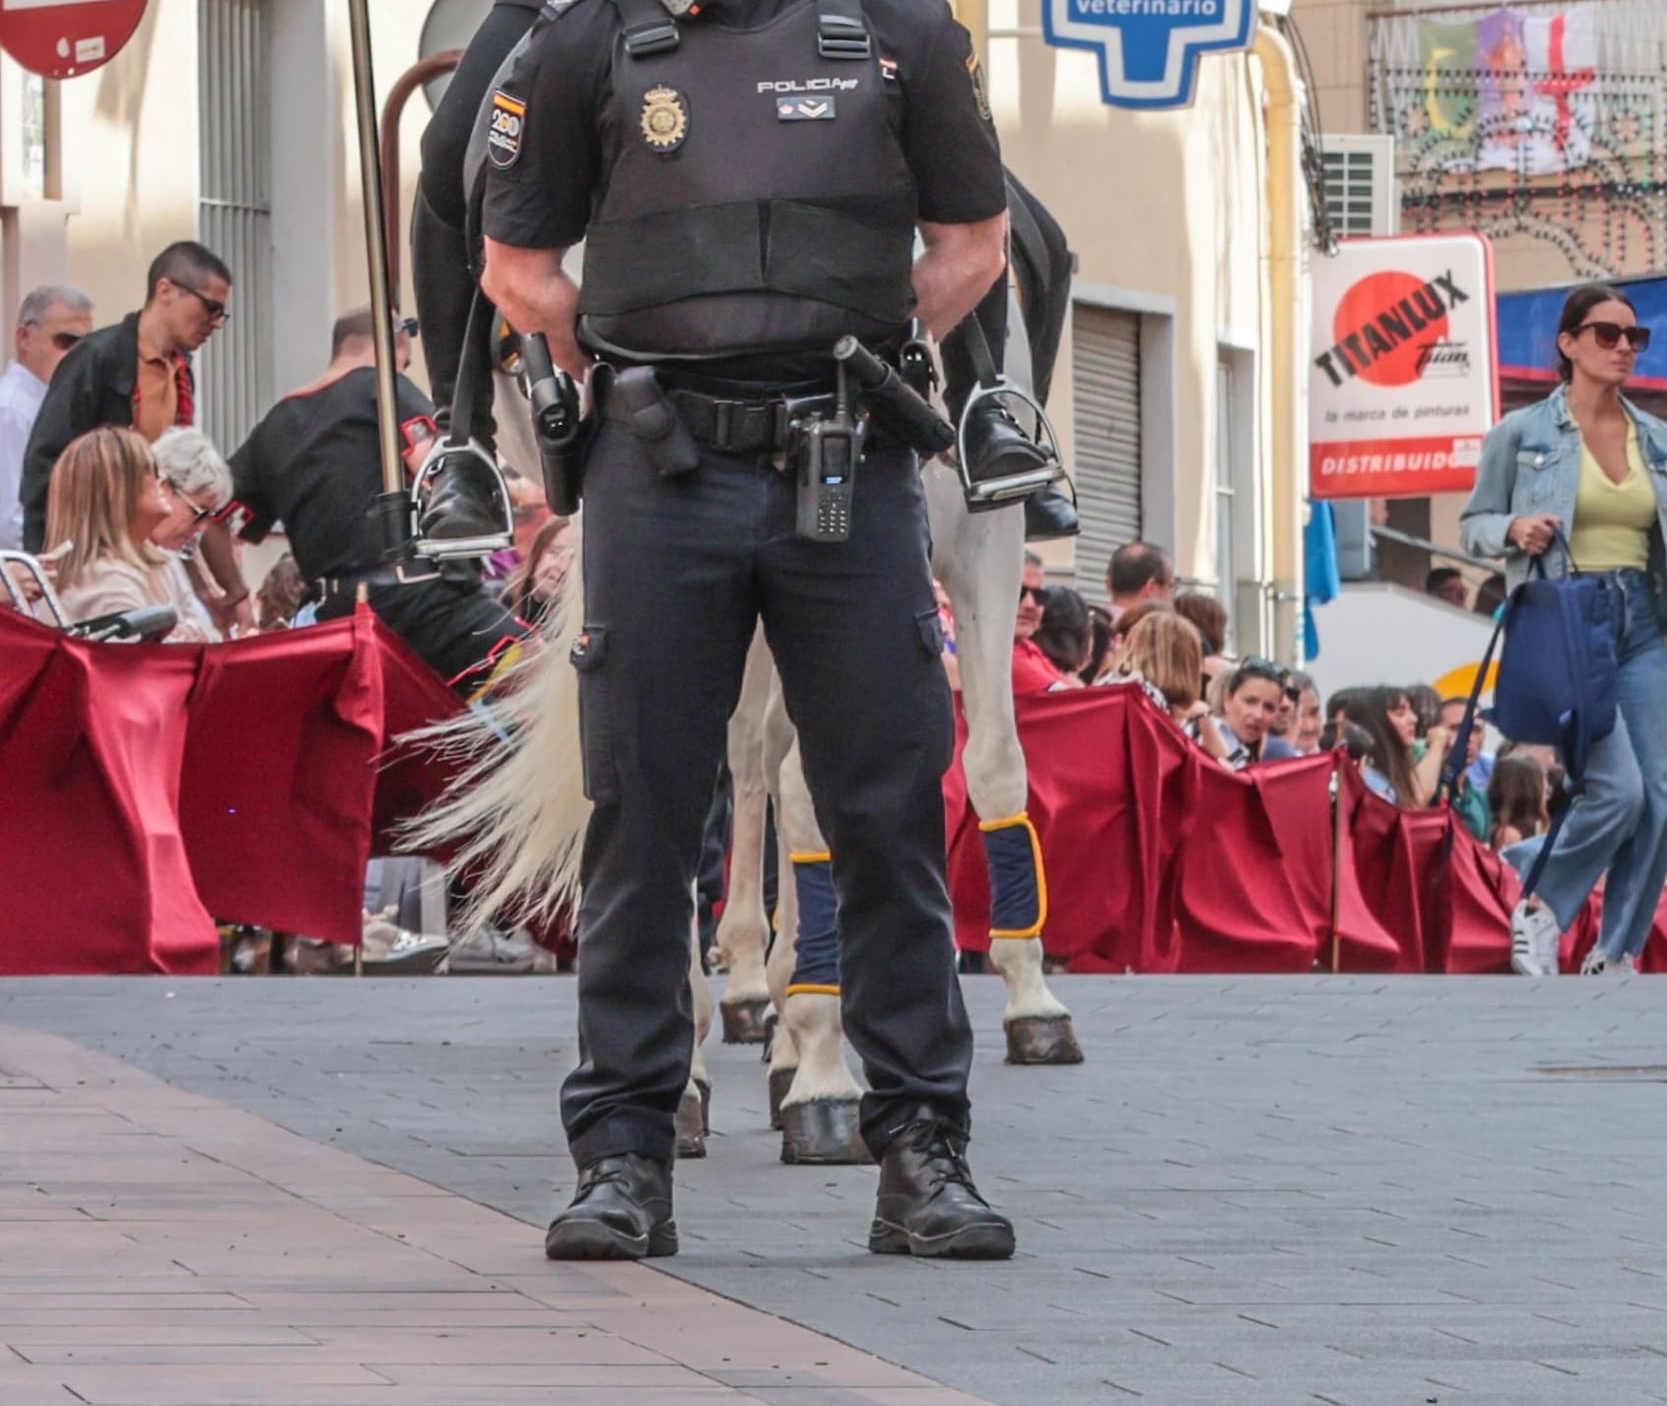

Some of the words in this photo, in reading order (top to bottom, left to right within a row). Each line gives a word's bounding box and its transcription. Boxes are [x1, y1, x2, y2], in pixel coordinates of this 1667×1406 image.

[1315, 269, 1469, 388] TITANLUX
[1325, 409, 1338, 423] la
[1343, 408, 1387, 422] marca
[1392, 405, 1409, 420] de
[1414, 404, 1470, 421] pinturas
